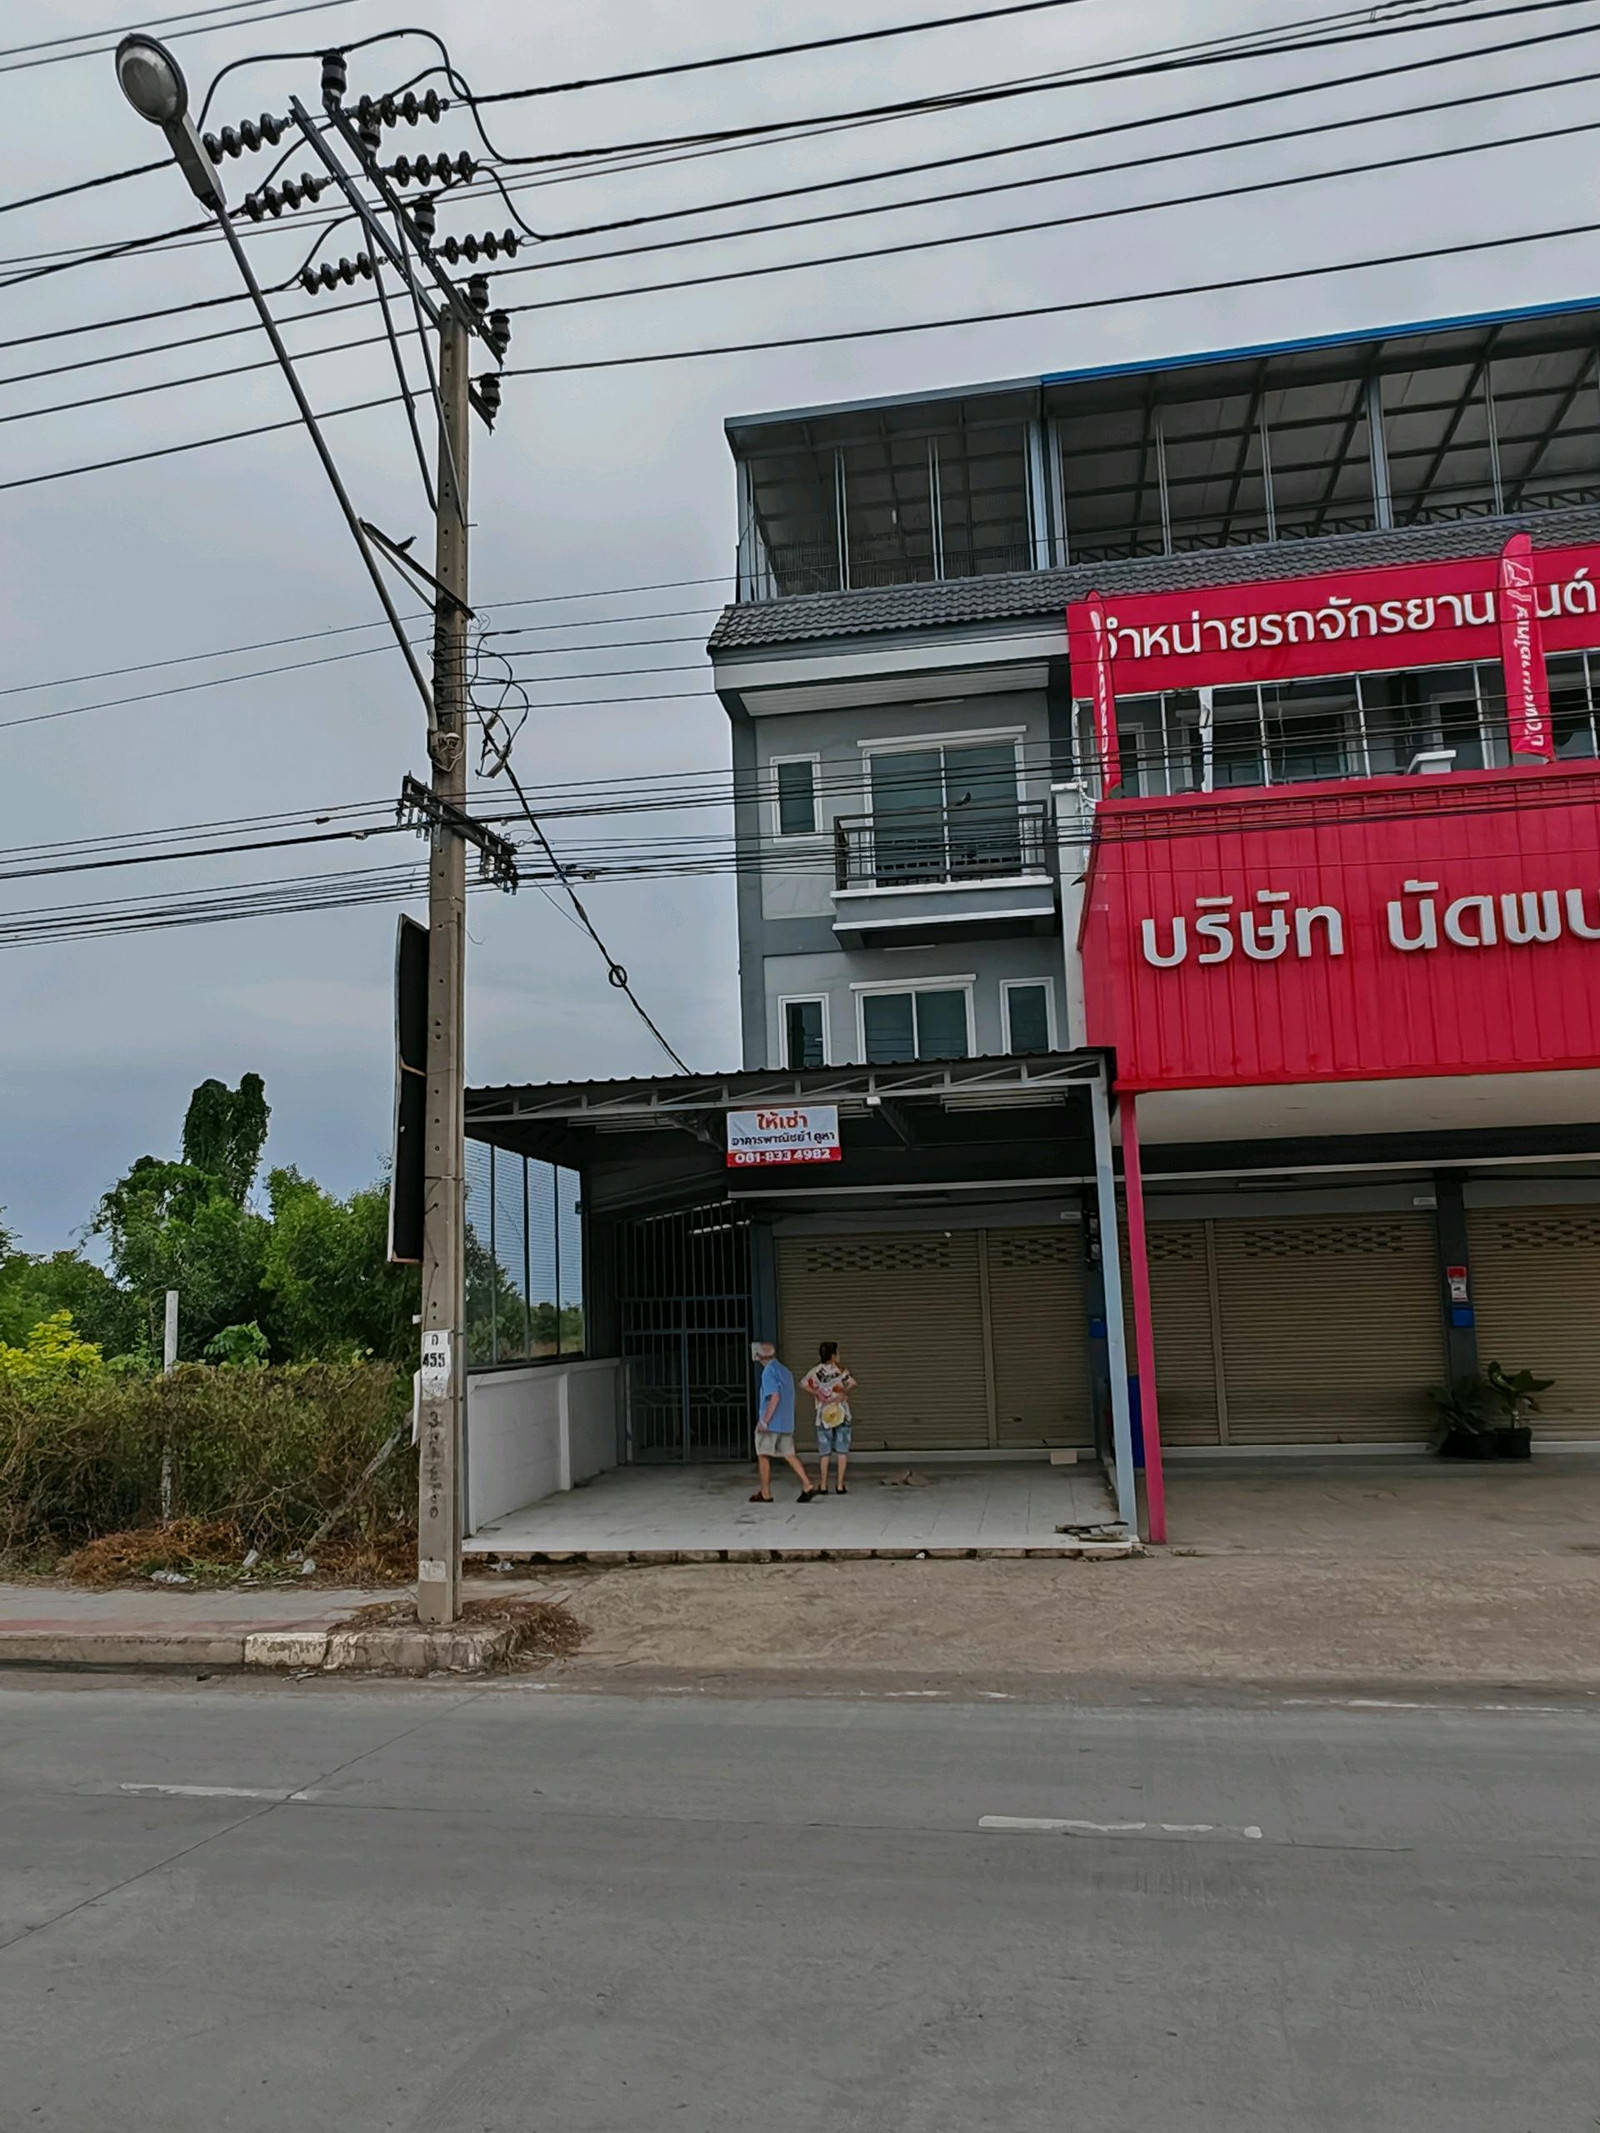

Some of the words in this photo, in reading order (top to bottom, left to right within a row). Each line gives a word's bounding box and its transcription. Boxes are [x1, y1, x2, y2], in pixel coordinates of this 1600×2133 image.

[1106, 567, 1598, 659] ำหน่ายรถจักรยานนต์
[1141, 889, 1344, 968] บริษัท
[756, 1110, 808, 1130] ให้เช่า
[423, 1352, 445, 1368] 455
